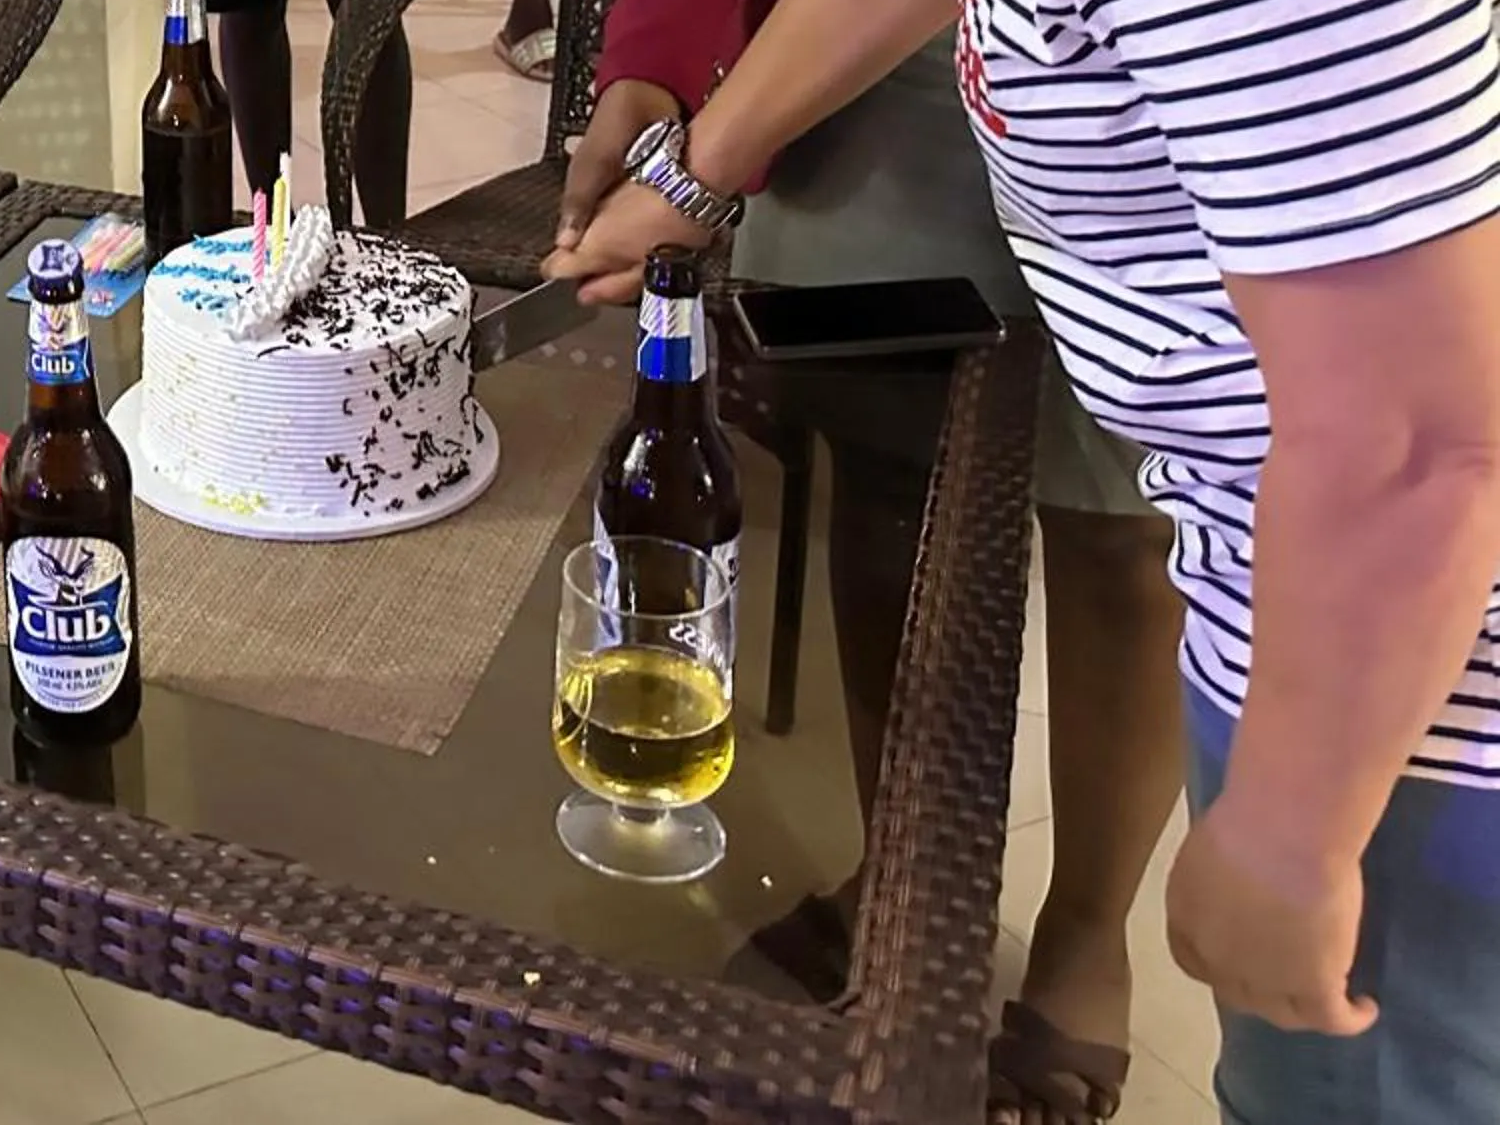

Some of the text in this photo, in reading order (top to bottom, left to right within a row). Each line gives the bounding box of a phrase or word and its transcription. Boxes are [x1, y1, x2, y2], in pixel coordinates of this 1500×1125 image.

[31, 353, 76, 375] Club
[21, 604, 111, 643] Club
[25, 660, 115, 680] PILSENER BEER
